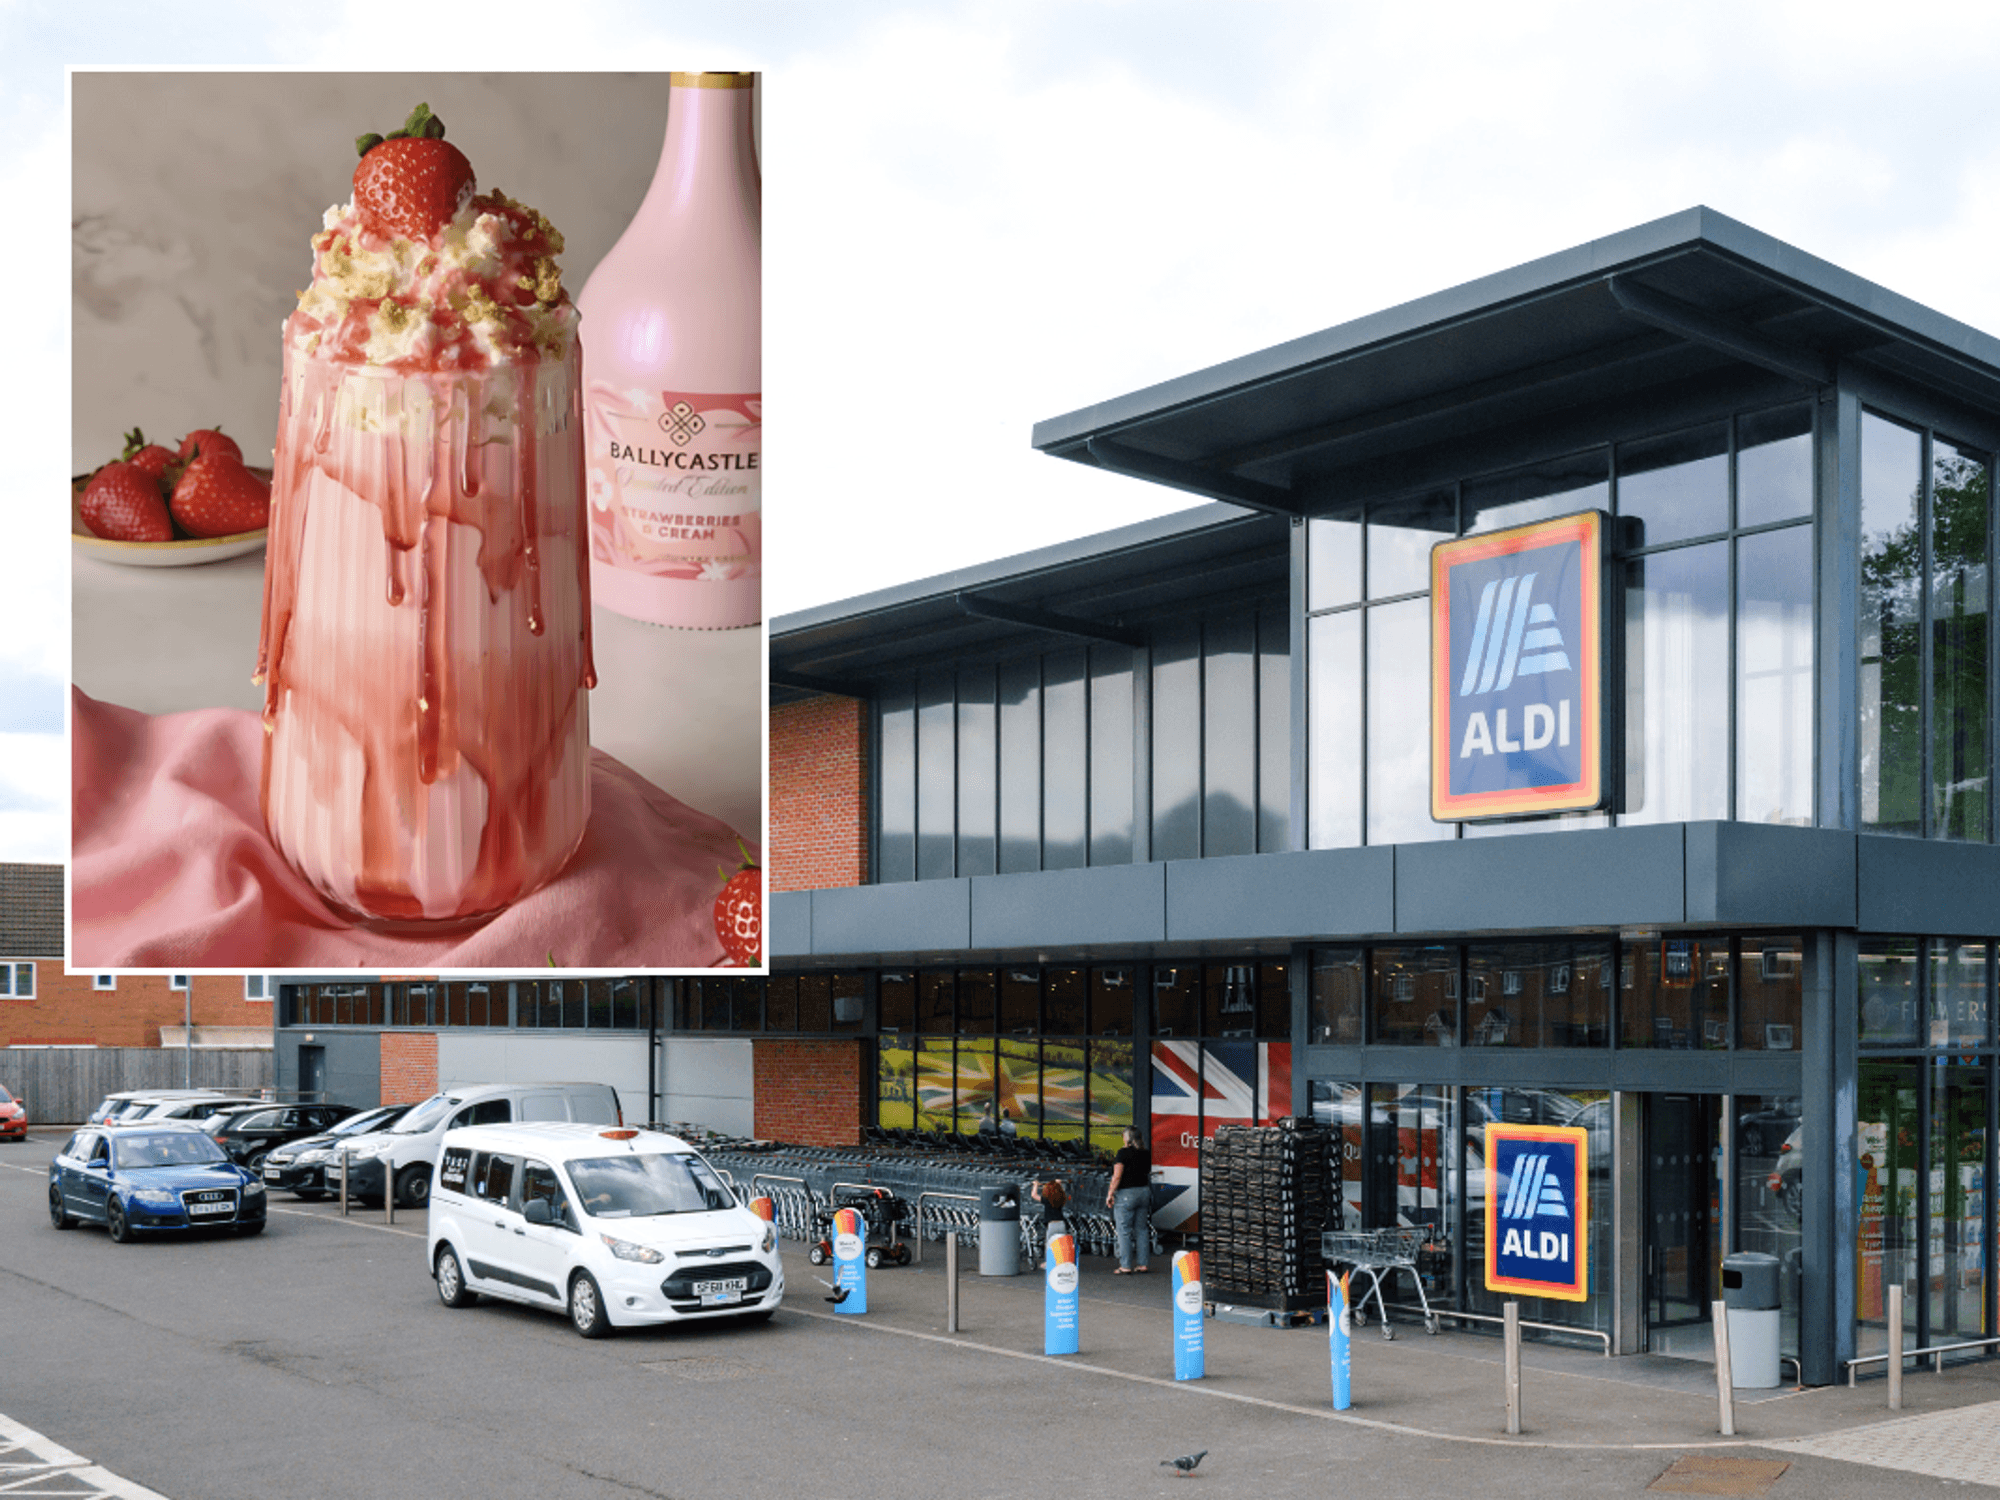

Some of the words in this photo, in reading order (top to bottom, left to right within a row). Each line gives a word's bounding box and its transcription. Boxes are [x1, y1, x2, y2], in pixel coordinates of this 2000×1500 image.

[610, 441, 759, 470] BALLYCASTLE
[658, 526, 715, 540] CREAM
[1460, 699, 1571, 759] ALDI
[1501, 1227, 1569, 1263] ALDI
